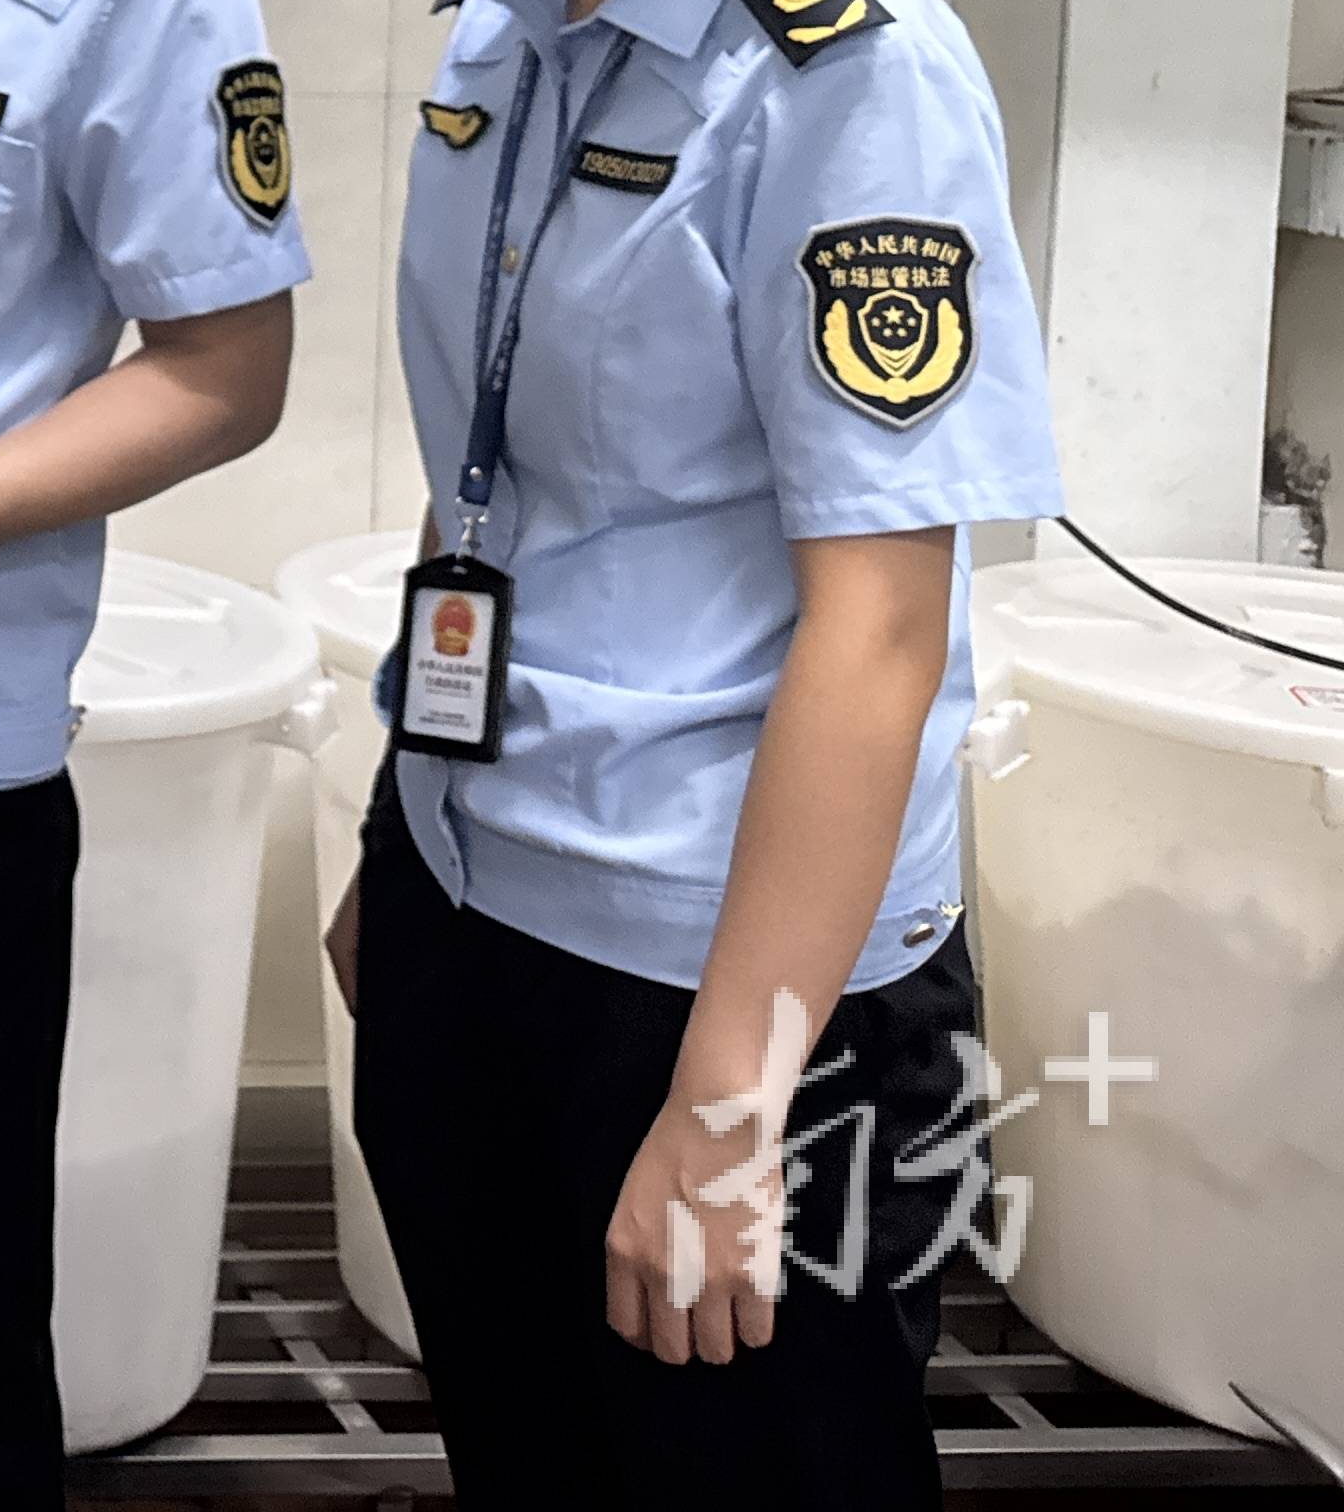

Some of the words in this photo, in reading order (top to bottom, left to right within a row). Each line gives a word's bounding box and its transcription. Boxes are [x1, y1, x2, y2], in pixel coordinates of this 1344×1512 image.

[814, 234, 962, 267] 中华人民共和国
[828, 265, 951, 288] 市场监管执法
